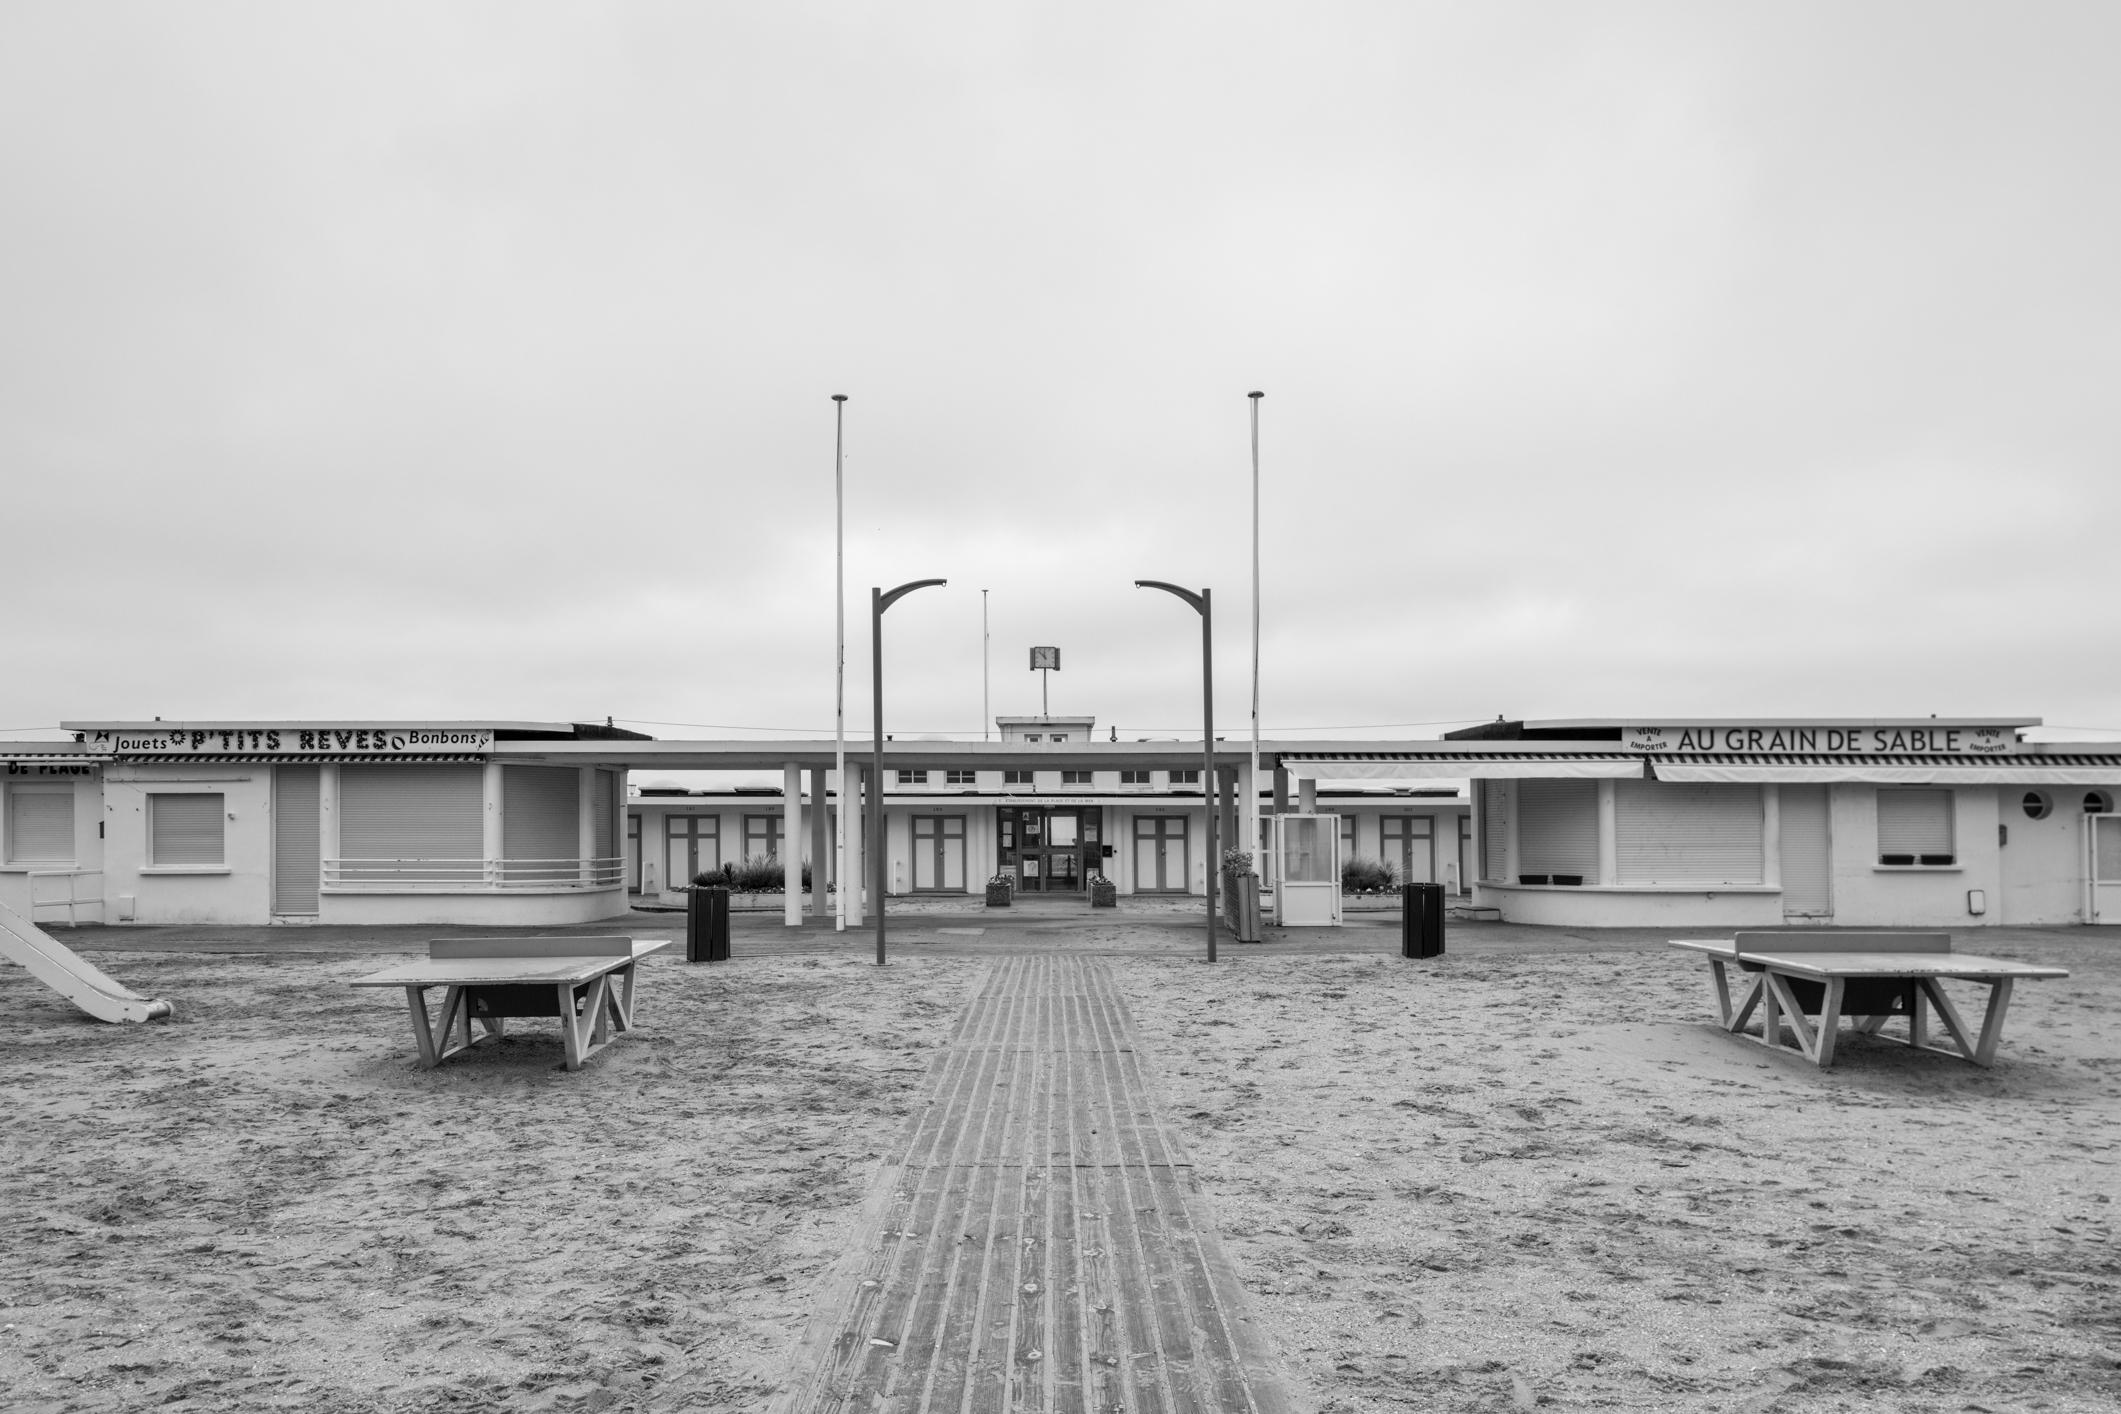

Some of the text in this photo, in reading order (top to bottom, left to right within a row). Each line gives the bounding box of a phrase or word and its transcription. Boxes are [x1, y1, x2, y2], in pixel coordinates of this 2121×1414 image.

[1636, 728, 1662, 737] VENTE
[1975, 728, 2000, 738] VENTE
[113, 730, 477, 753] Jouets P'TITS REVES Bonbons
[1678, 729, 1961, 752] AU GRAIN DE SABLE
[1630, 741, 1668, 751] EMPORTER
[1969, 743, 2007, 753] EMPORTER
